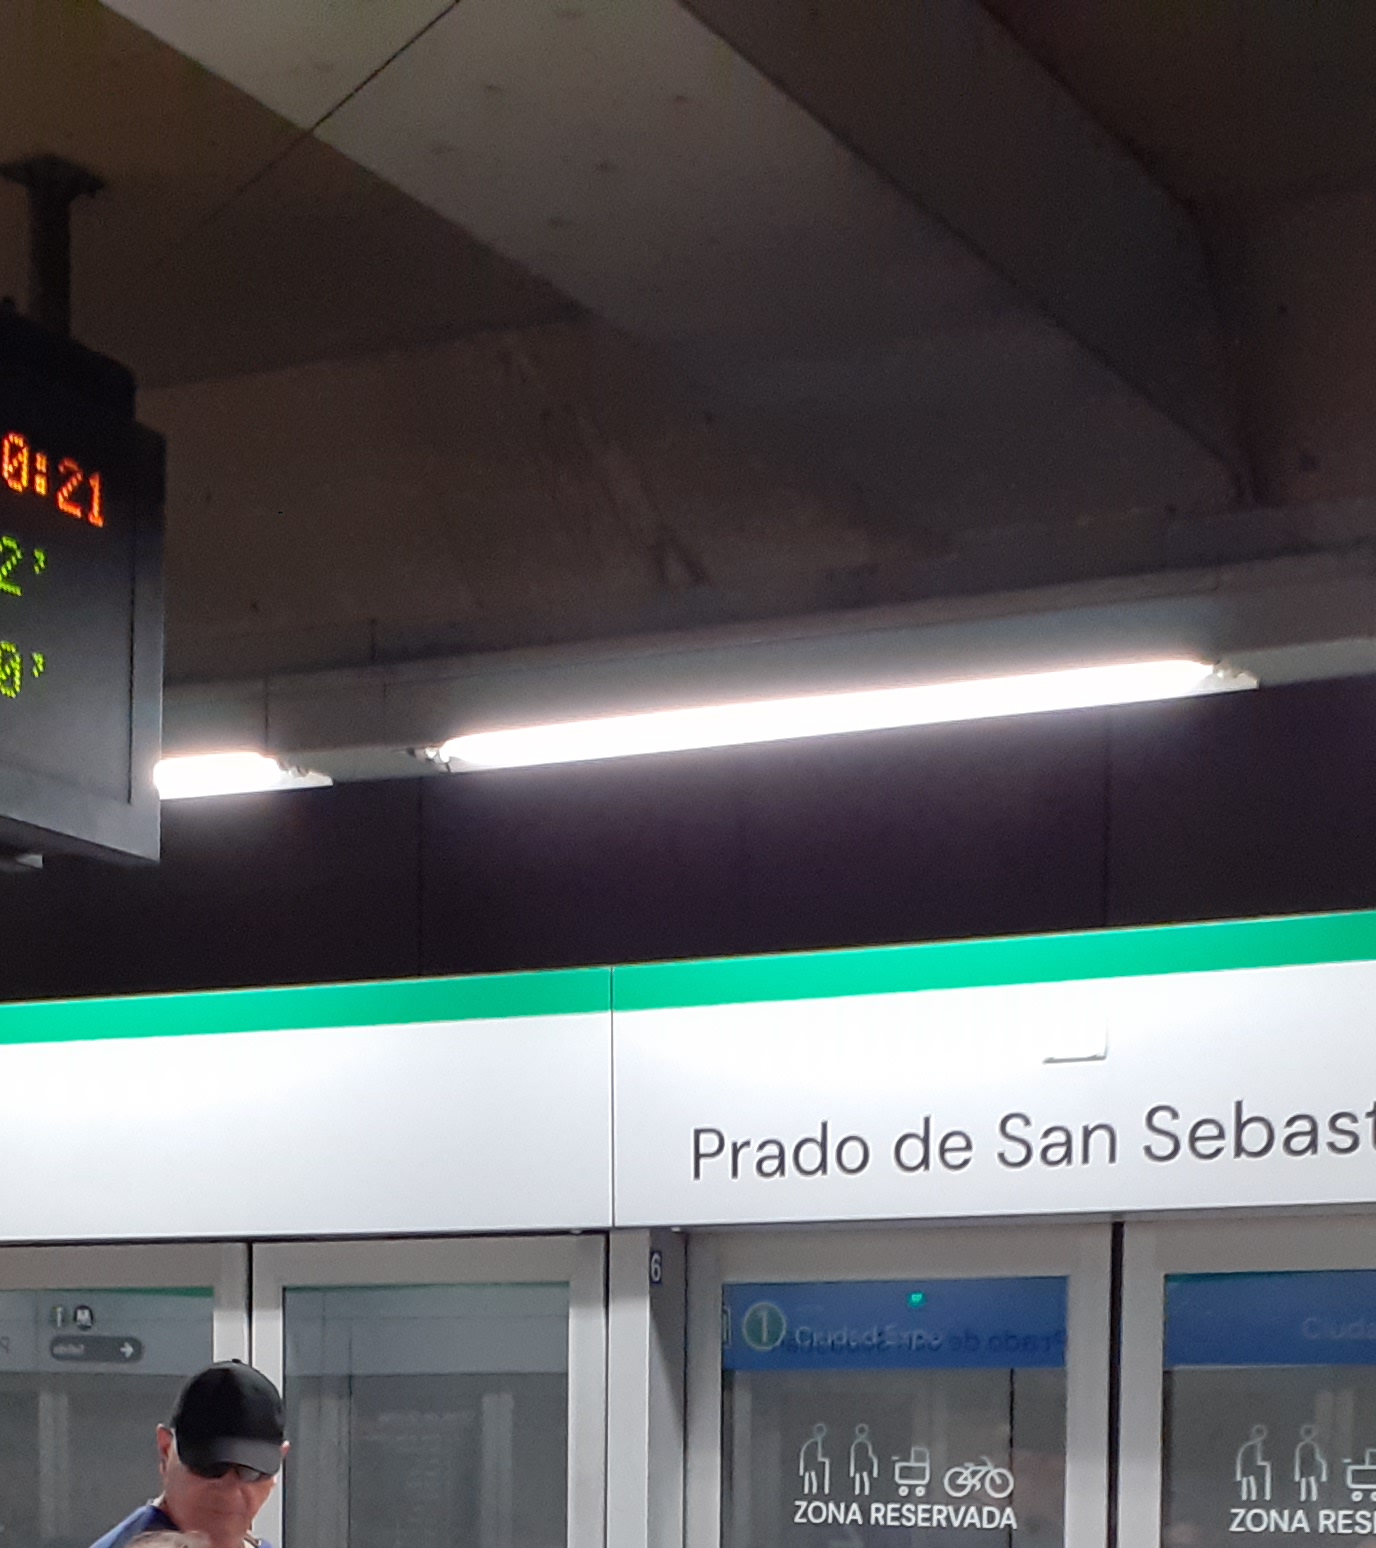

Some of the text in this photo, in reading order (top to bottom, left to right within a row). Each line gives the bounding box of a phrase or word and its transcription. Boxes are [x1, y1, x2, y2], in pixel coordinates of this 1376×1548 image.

[691, 1118, 871, 1182] Prado
[892, 1114, 974, 1174] de
[996, 1109, 1119, 1170] San
[651, 1253, 662, 1282] 6
[793, 1500, 1018, 1531] ZONA RESERVADA
[1228, 1507, 1309, 1534] ZONA
